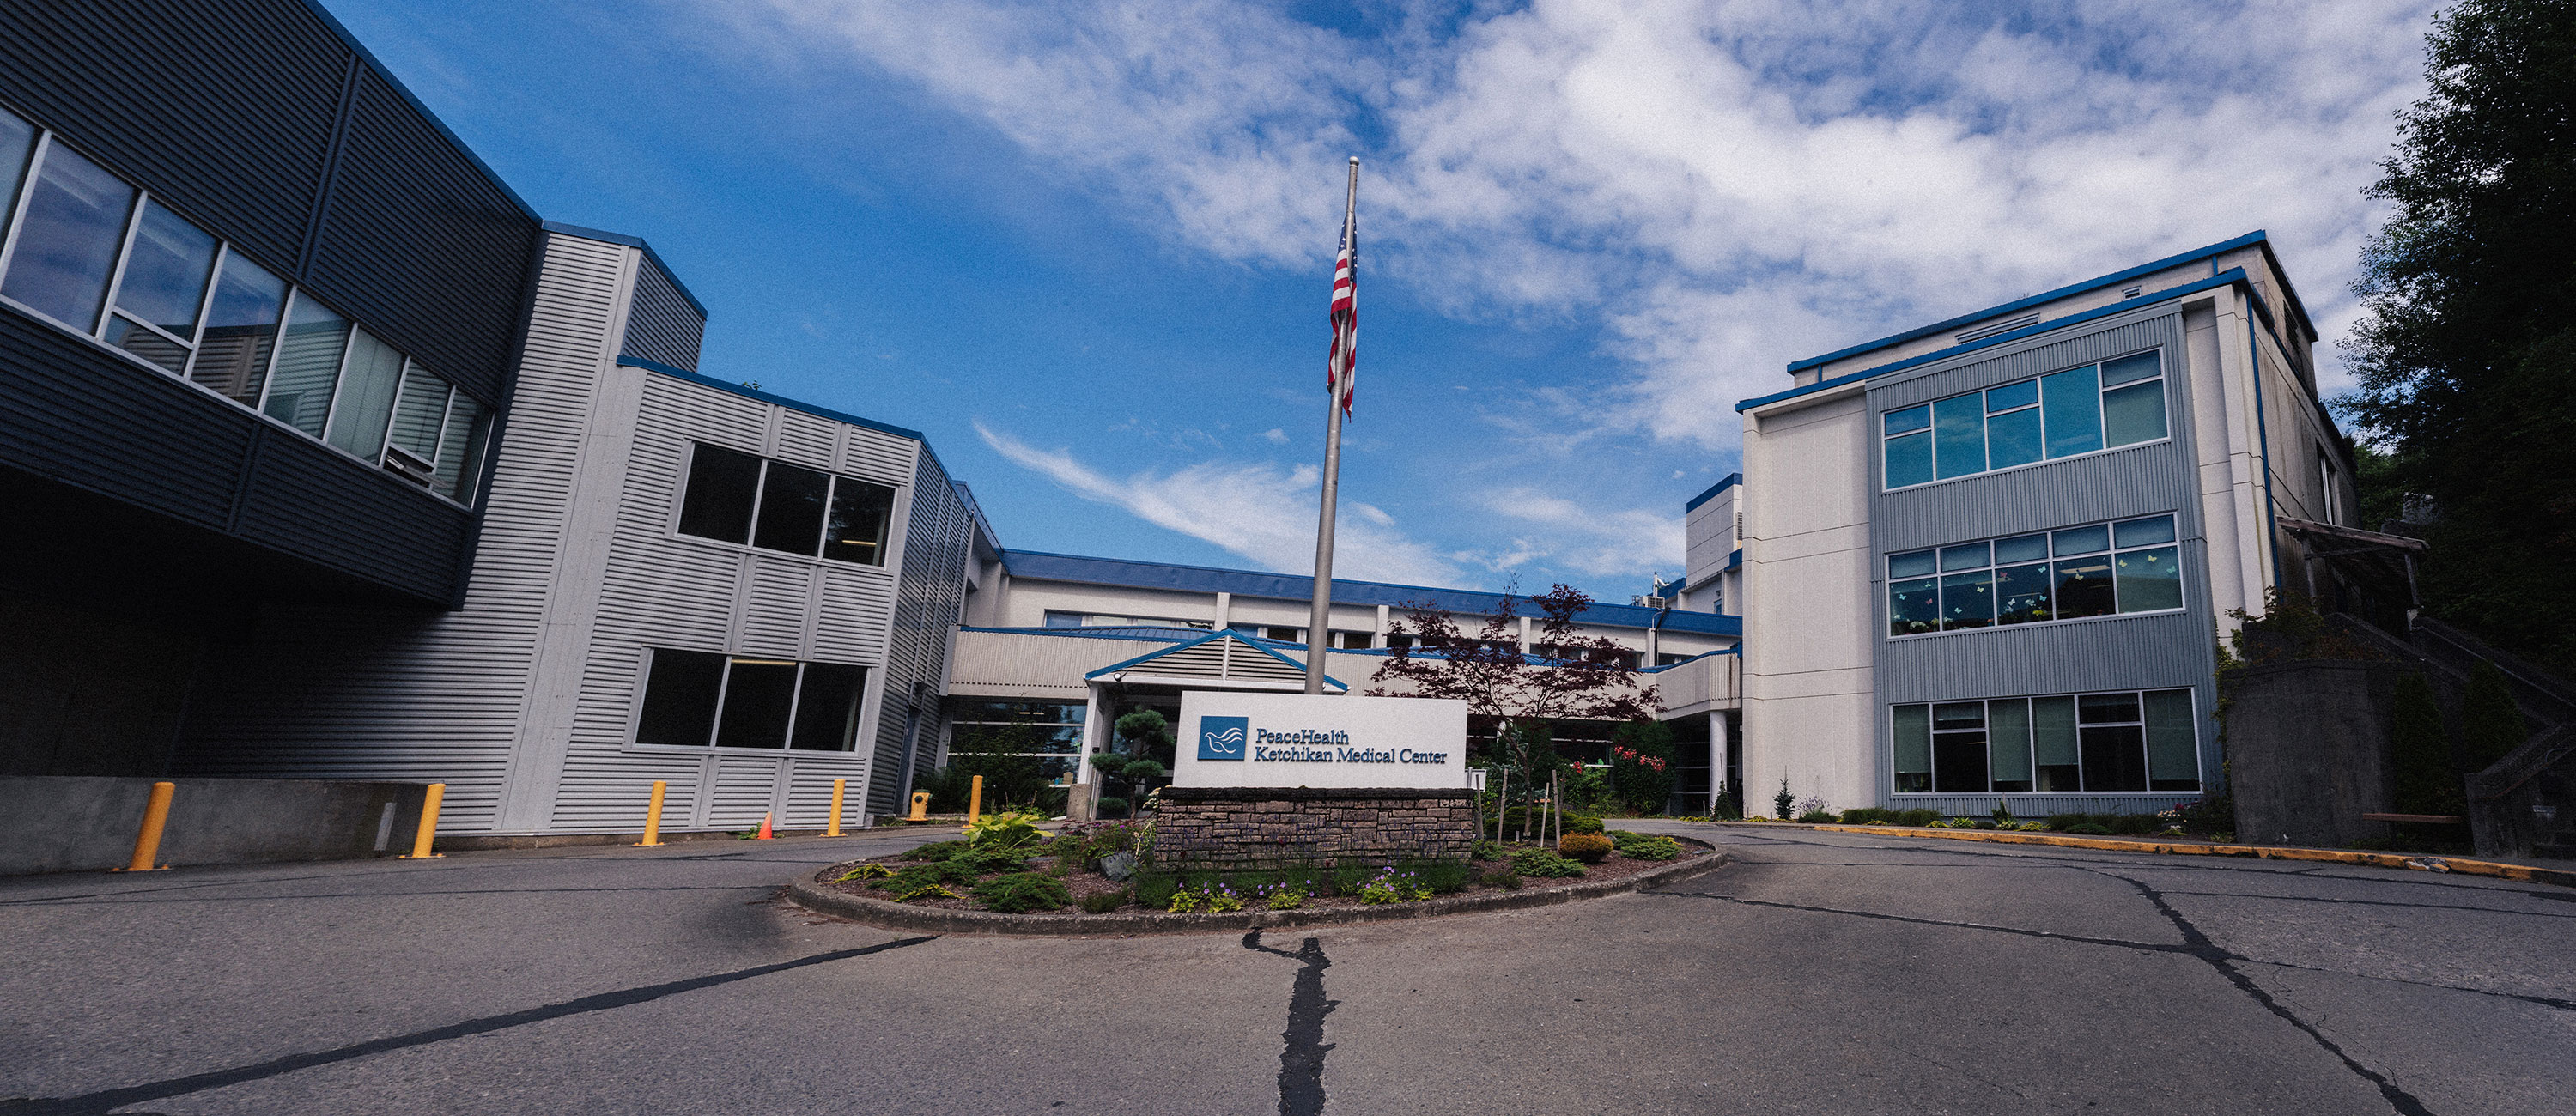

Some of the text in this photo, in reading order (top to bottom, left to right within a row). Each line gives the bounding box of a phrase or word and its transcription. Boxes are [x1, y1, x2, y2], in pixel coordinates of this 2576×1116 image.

[1255, 728, 1349, 745] PeaceHealth
[1254, 746, 1448, 765] Ketchikan Medical Center
